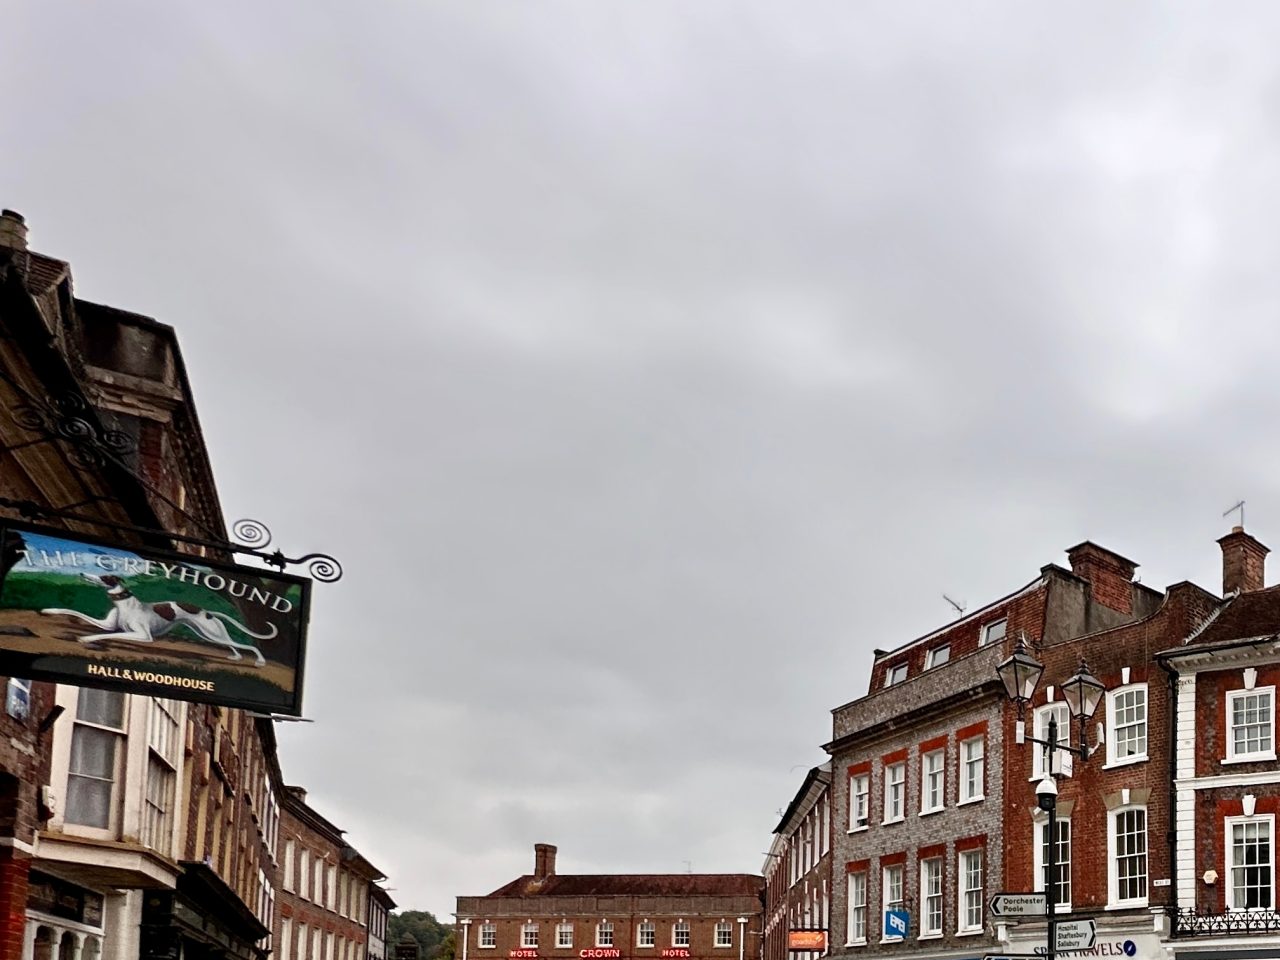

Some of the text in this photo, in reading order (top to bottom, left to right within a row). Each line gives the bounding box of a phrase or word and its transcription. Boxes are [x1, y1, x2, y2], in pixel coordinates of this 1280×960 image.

[15, 549, 293, 613] THE GREYHOUND
[134, 671, 215, 691] WOODHOUSE
[1058, 924, 1078, 932] Hospital
[1058, 932, 1087, 940] Shaftesbury
[1058, 940, 1080, 948] Salisbury
[580, 950, 620, 958] CROWN
